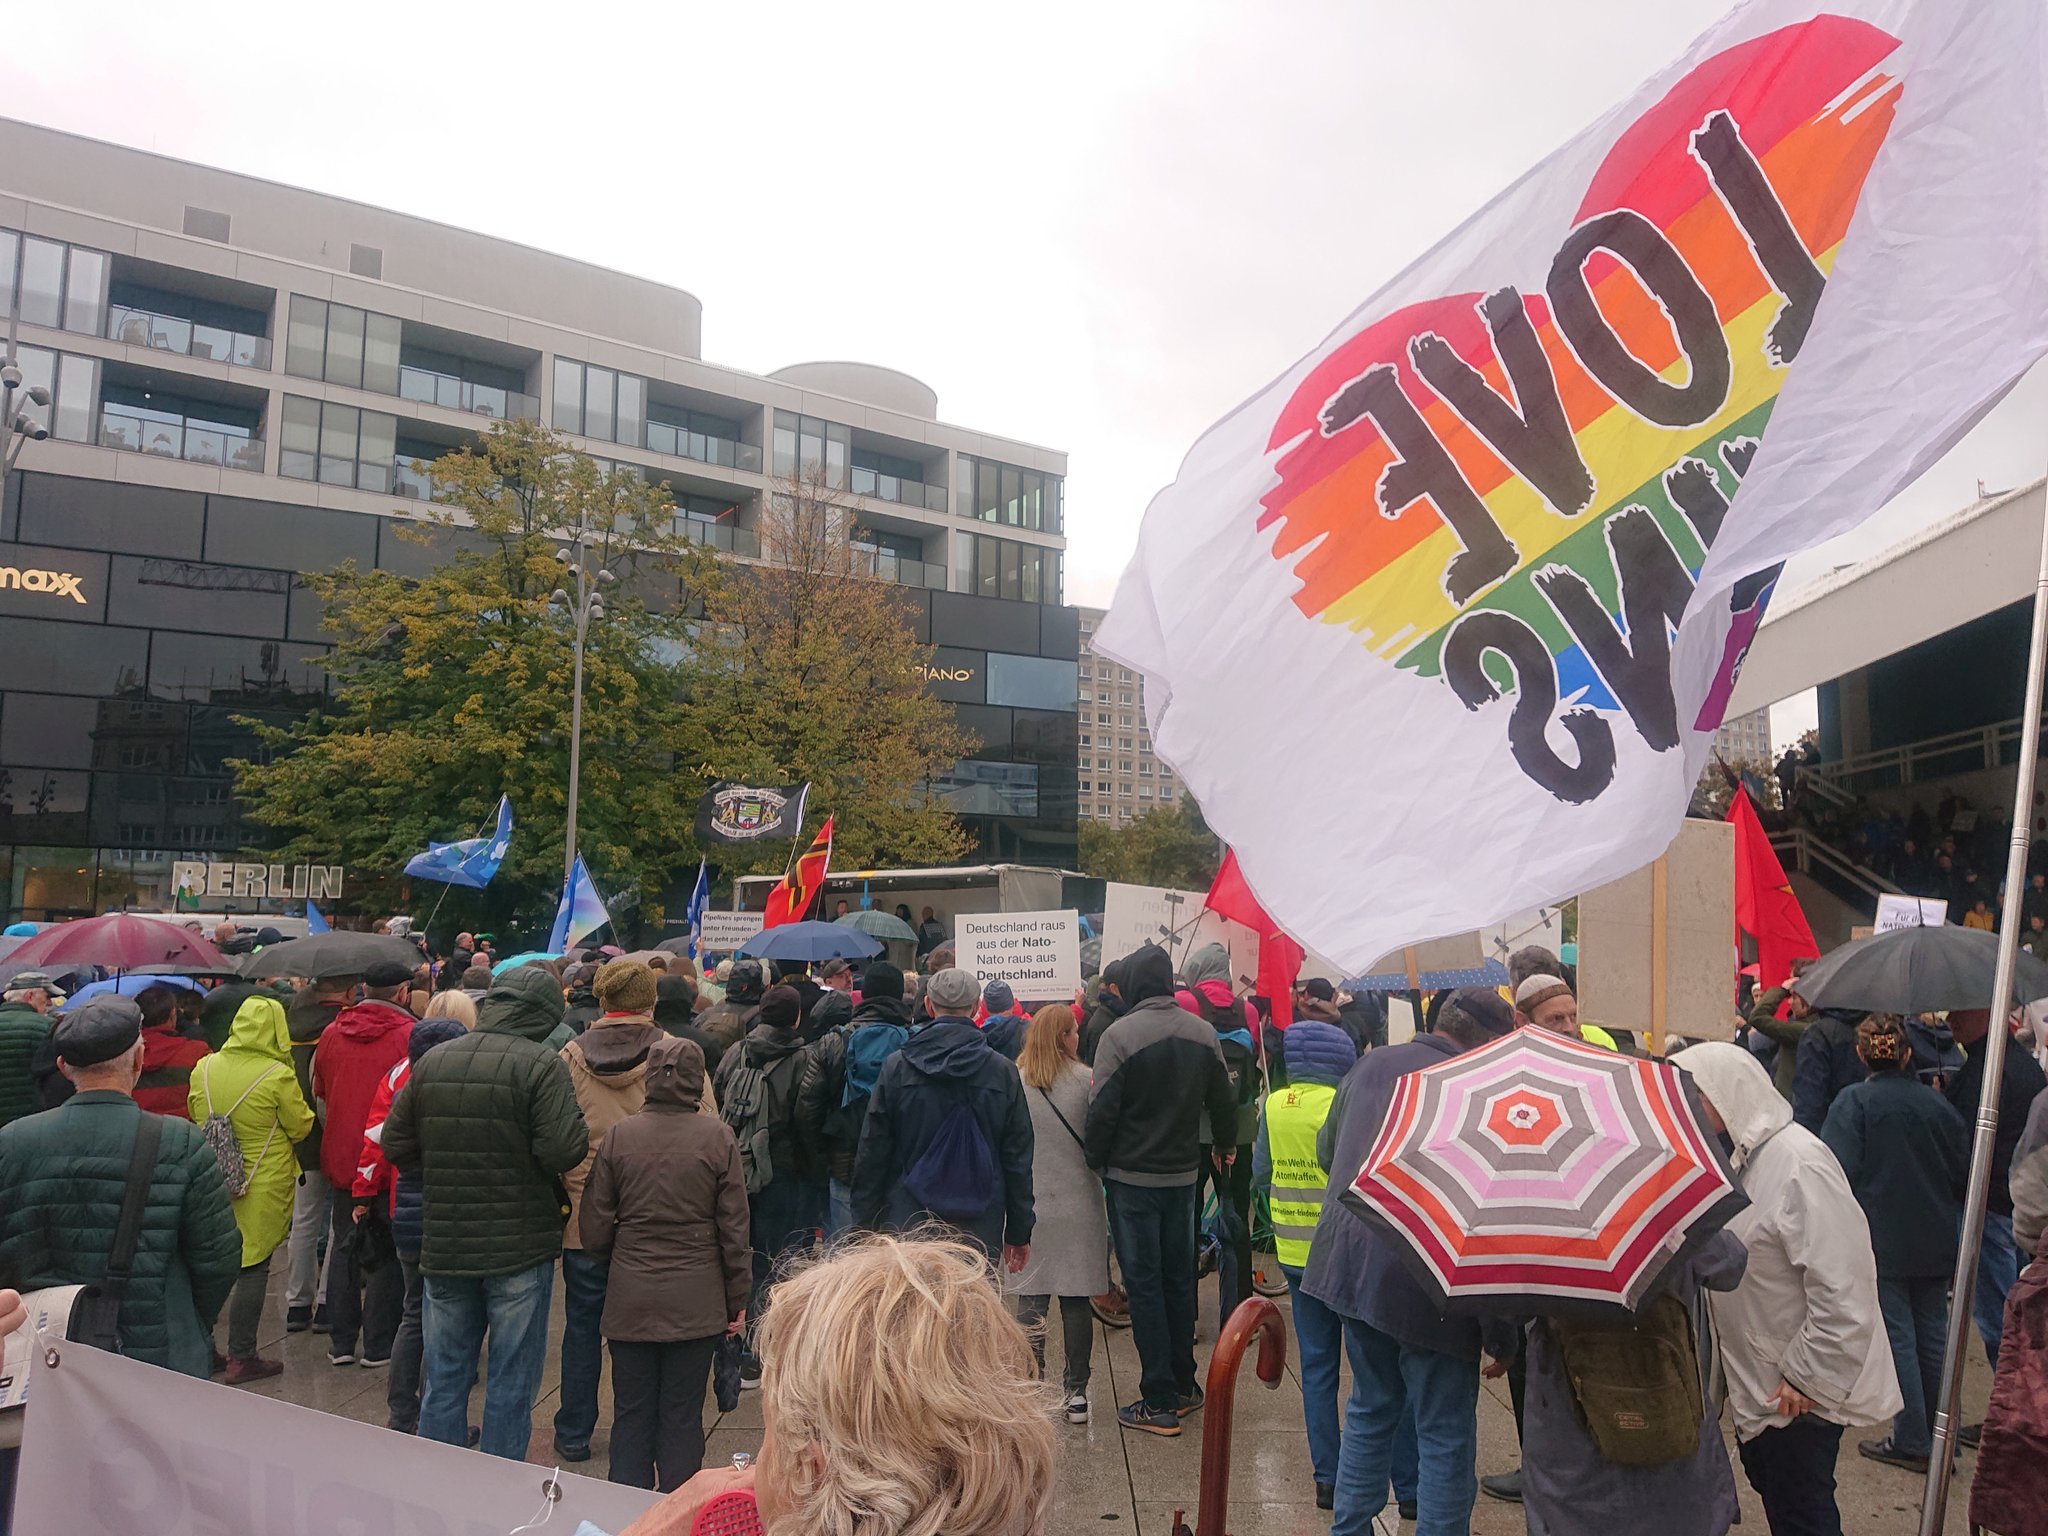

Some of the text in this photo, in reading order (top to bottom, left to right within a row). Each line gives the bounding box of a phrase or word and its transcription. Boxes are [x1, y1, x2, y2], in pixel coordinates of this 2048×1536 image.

[171, 861, 344, 899] BERLIN
[966, 921, 1066, 934] Deutschland raus
[976, 937, 1056, 949] aus der Nato-
[977, 953, 1057, 965] Nato raus aus
[977, 968, 1057, 981] Deutschland.
[1288, 1158, 1306, 1168] Welt
